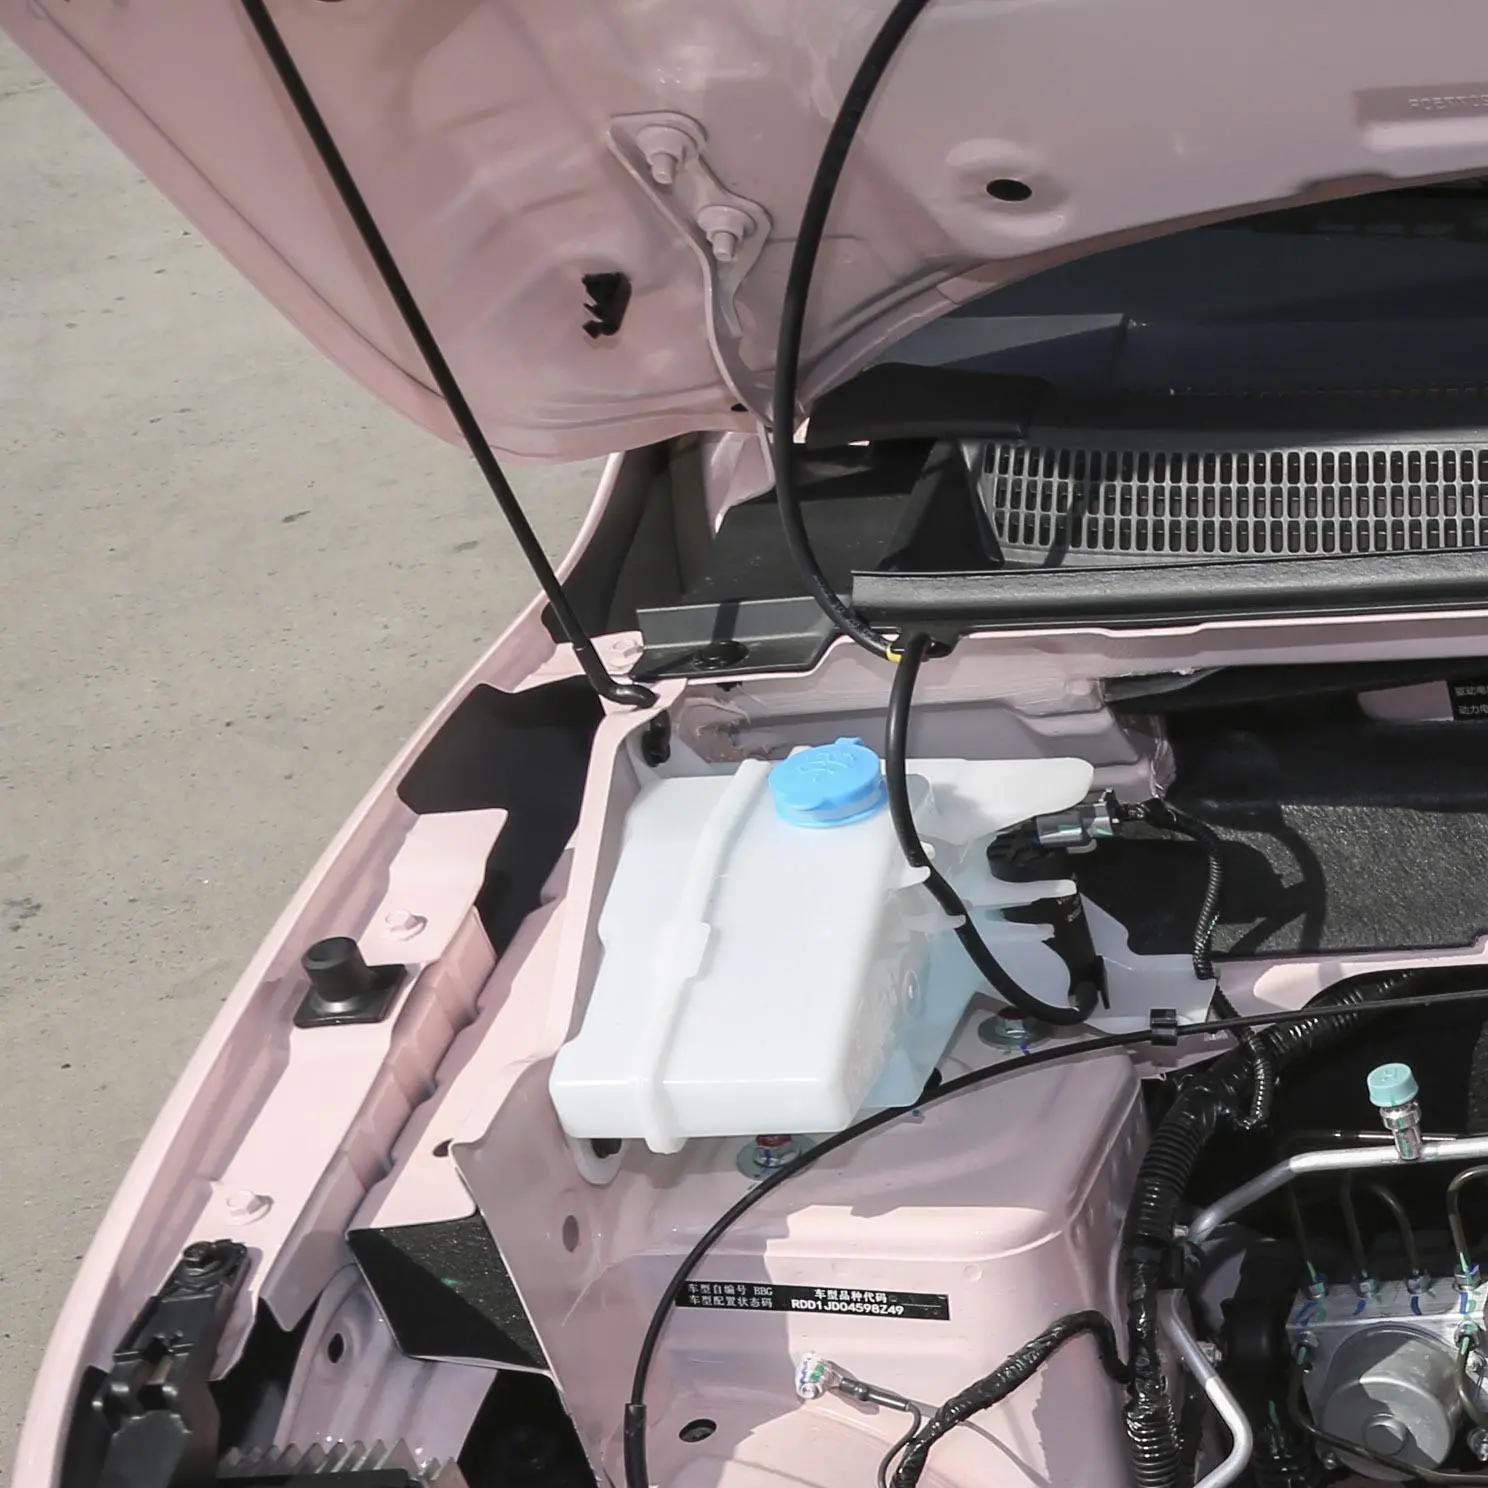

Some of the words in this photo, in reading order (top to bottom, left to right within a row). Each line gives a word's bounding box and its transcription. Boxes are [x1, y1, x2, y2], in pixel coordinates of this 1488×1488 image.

[688, 1283, 746, 1295] 车型自编号
[814, 1288, 888, 1302] 车型品种代码
[689, 1294, 772, 1308] 车型配置状态码
